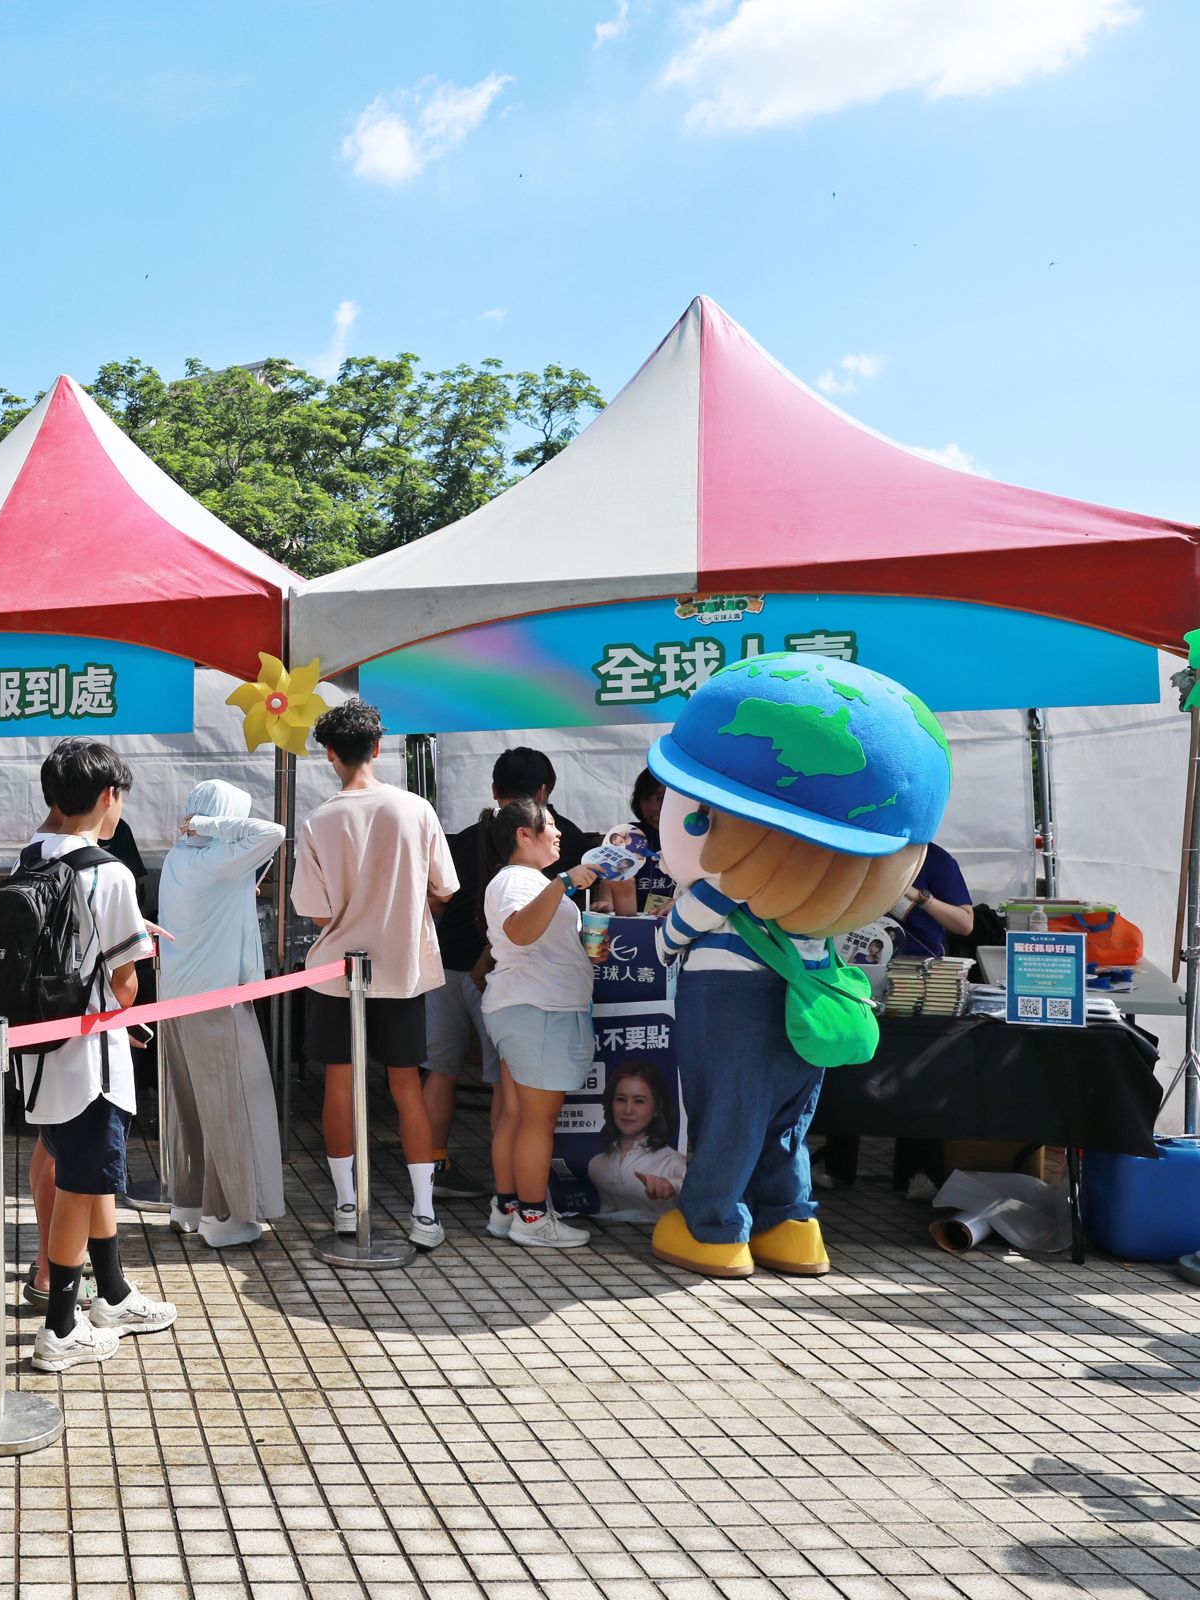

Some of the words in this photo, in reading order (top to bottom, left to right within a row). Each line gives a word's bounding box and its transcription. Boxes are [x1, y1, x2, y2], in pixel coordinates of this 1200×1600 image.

[597, 635, 853, 701] 全球
[594, 1024, 670, 1052] 不要點
